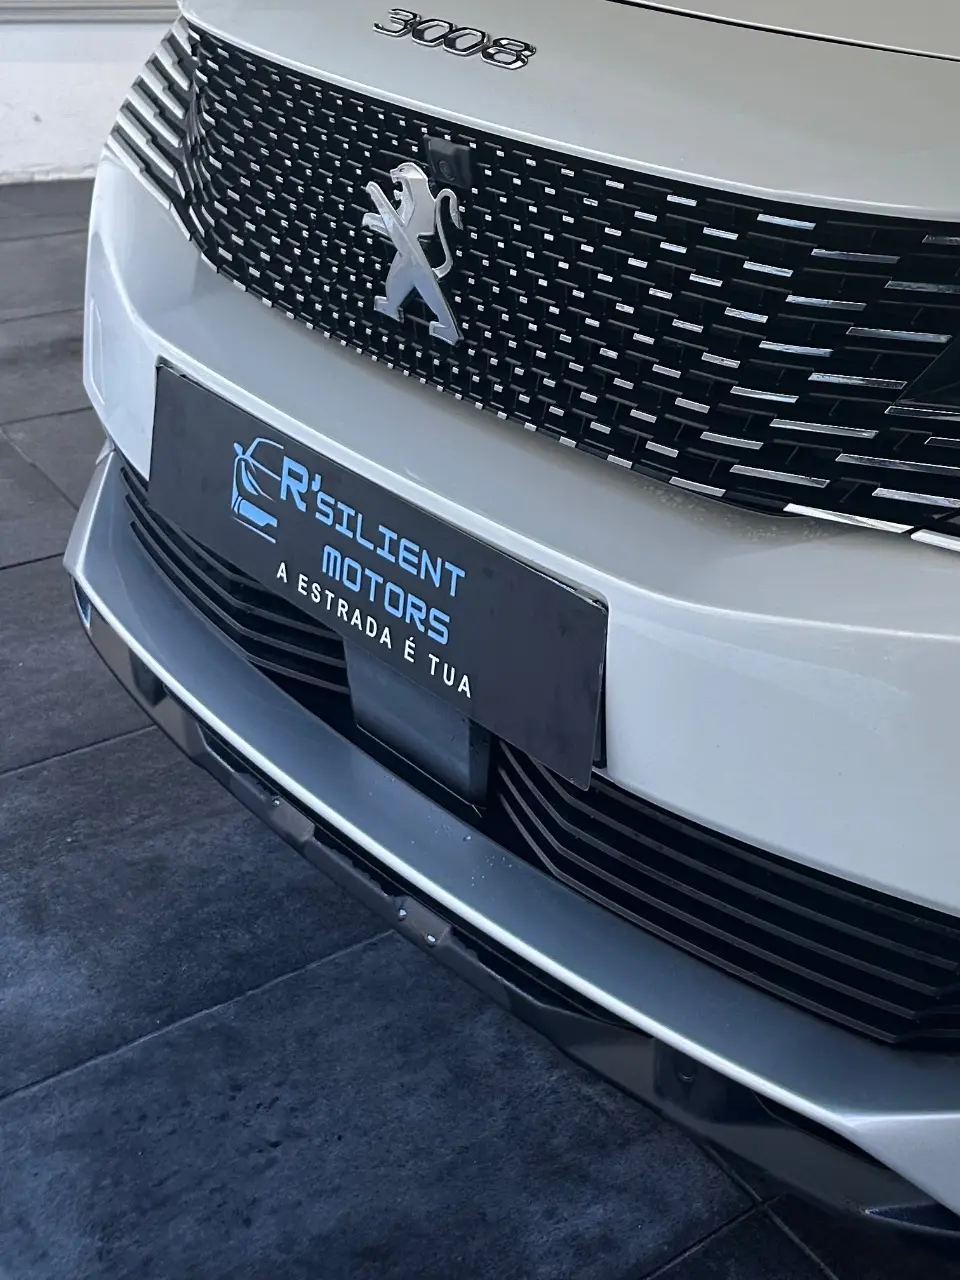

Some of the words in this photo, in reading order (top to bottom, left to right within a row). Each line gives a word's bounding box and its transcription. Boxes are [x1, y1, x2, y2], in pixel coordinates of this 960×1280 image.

[372, 8, 537, 71] 3008
[280, 455, 466, 597] R'SILIENT
[276, 562, 288, 584] A
[297, 574, 393, 650] ESTRADA
[403, 636, 416, 663] É
[428, 653, 473, 699] TUA
[322, 544, 451, 645] MOTORS
